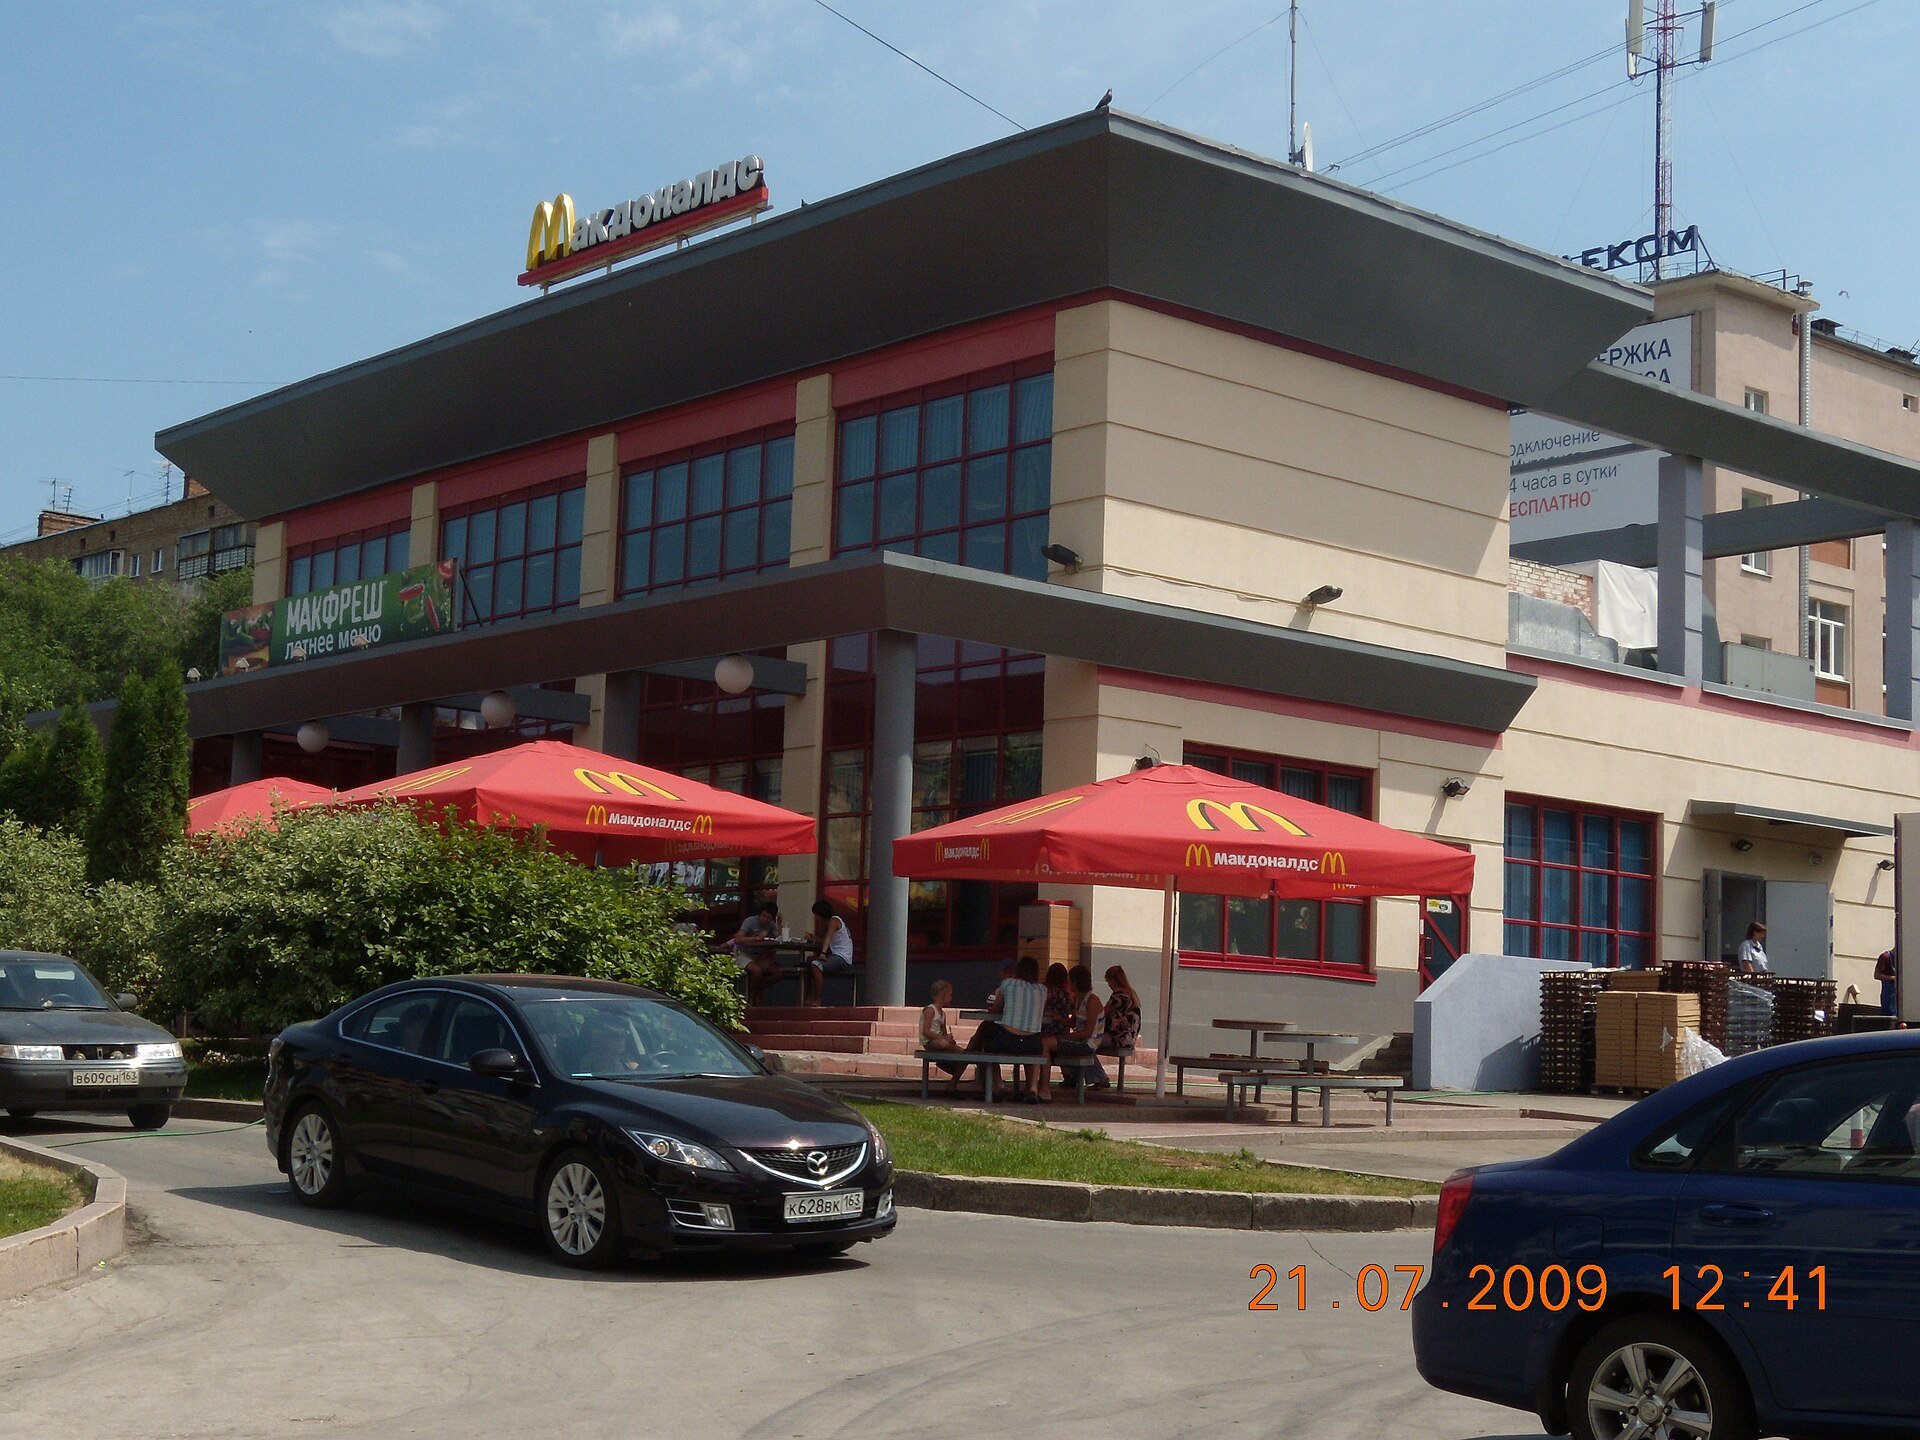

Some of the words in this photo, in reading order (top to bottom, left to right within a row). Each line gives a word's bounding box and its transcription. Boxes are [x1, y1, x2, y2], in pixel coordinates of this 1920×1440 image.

[526, 154, 764, 271] Макдоналдс
[1562, 225, 1698, 271] ЕКОМ
[1523, 474, 1557, 491] часа
[1563, 473, 1571, 484] в
[286, 580, 384, 637] МАКФРЕШ
[609, 812, 692, 831] Макдоналдс
[1214, 852, 1319, 871] Макдоналдс
[788, 1198, 840, 1215] К628ВК
[844, 1193, 860, 1207] 163
